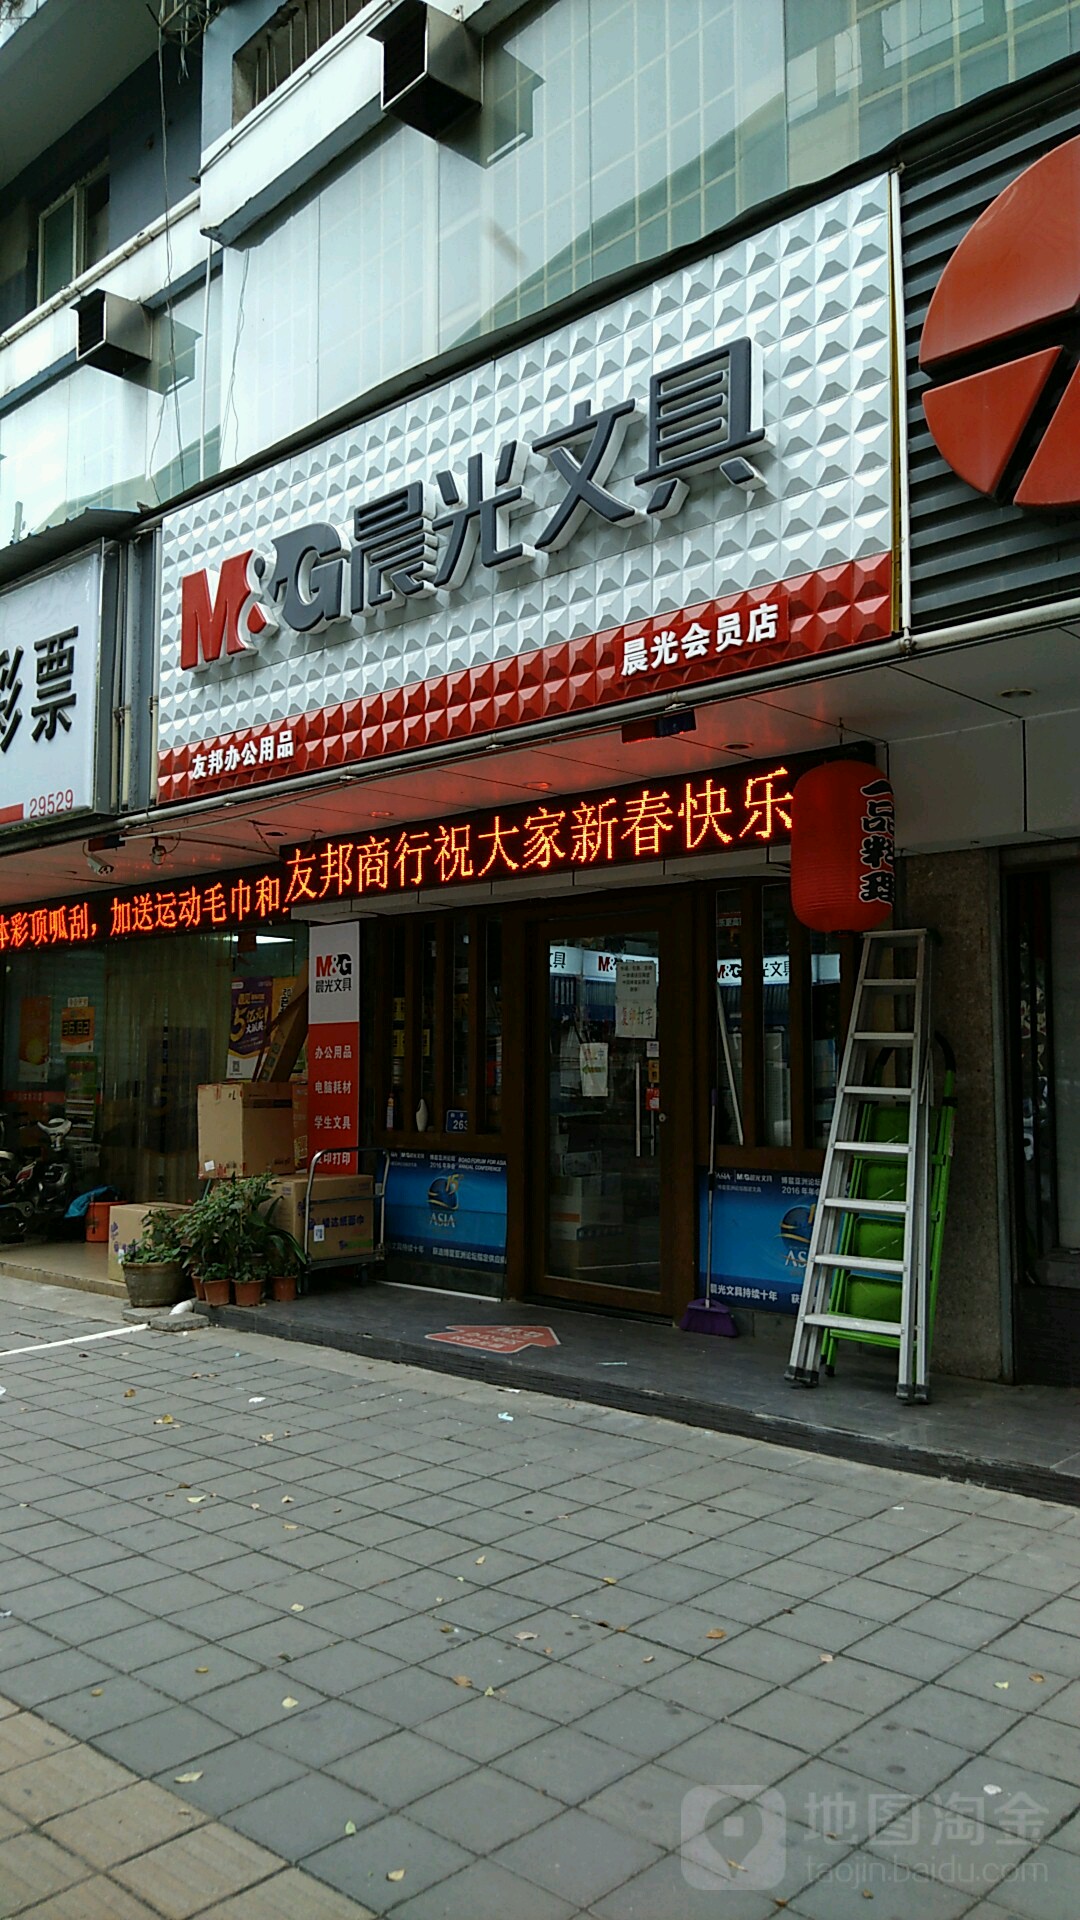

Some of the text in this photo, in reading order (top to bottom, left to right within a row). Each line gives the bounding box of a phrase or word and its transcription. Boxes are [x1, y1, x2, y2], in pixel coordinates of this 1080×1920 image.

[180, 336, 774, 672] M&G 晨光文具
[620, 602, 779, 677] 晨光会员店
[191, 729, 295, 780] 友邦办公用品
[284, 766, 793, 904] 友邦商行祝大家新春快乐
[315, 953, 352, 978] M&G
[598, 955, 617, 972] M&
[315, 978, 352, 993] 晨光文具
[315, 1045, 352, 1060] 办公用品
[315, 1080, 352, 1095] 电脑耗材
[315, 1115, 352, 1130] 学生文具
[781, 1186, 800, 1195] 2016
[430, 1211, 456, 1229] ASIA
[784, 1249, 807, 1267] AS
